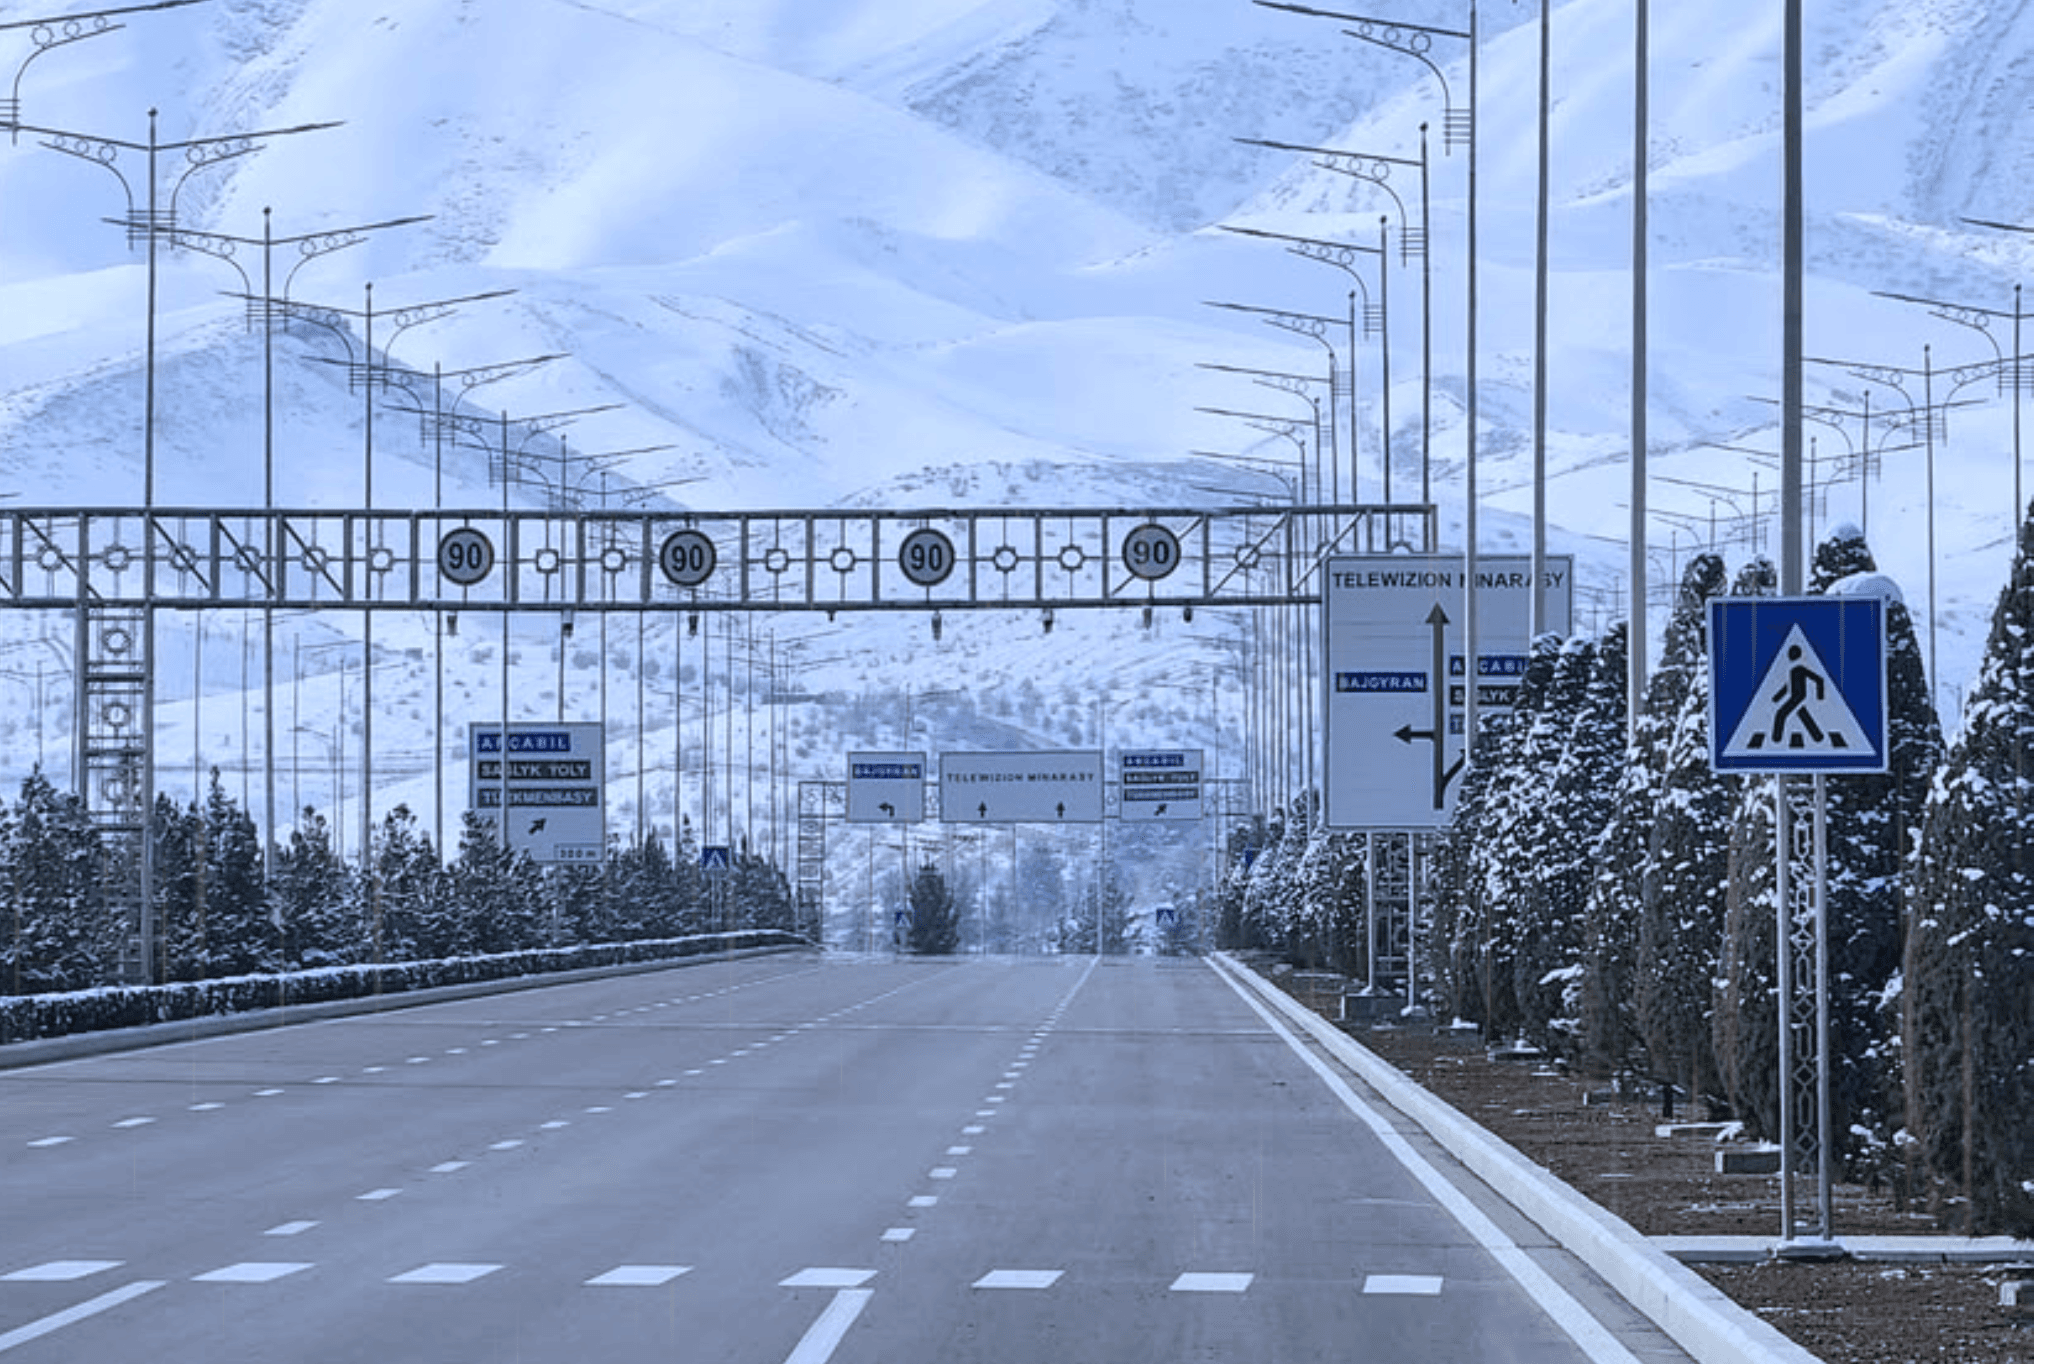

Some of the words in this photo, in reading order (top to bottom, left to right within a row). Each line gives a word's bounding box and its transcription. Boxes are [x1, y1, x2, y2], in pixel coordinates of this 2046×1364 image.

[448, 542, 483, 570] 90
[671, 544, 702, 572] 90
[910, 543, 943, 572] 90
[1133, 541, 1169, 565] 90
[1332, 572, 1451, 588] TELEWIZION
